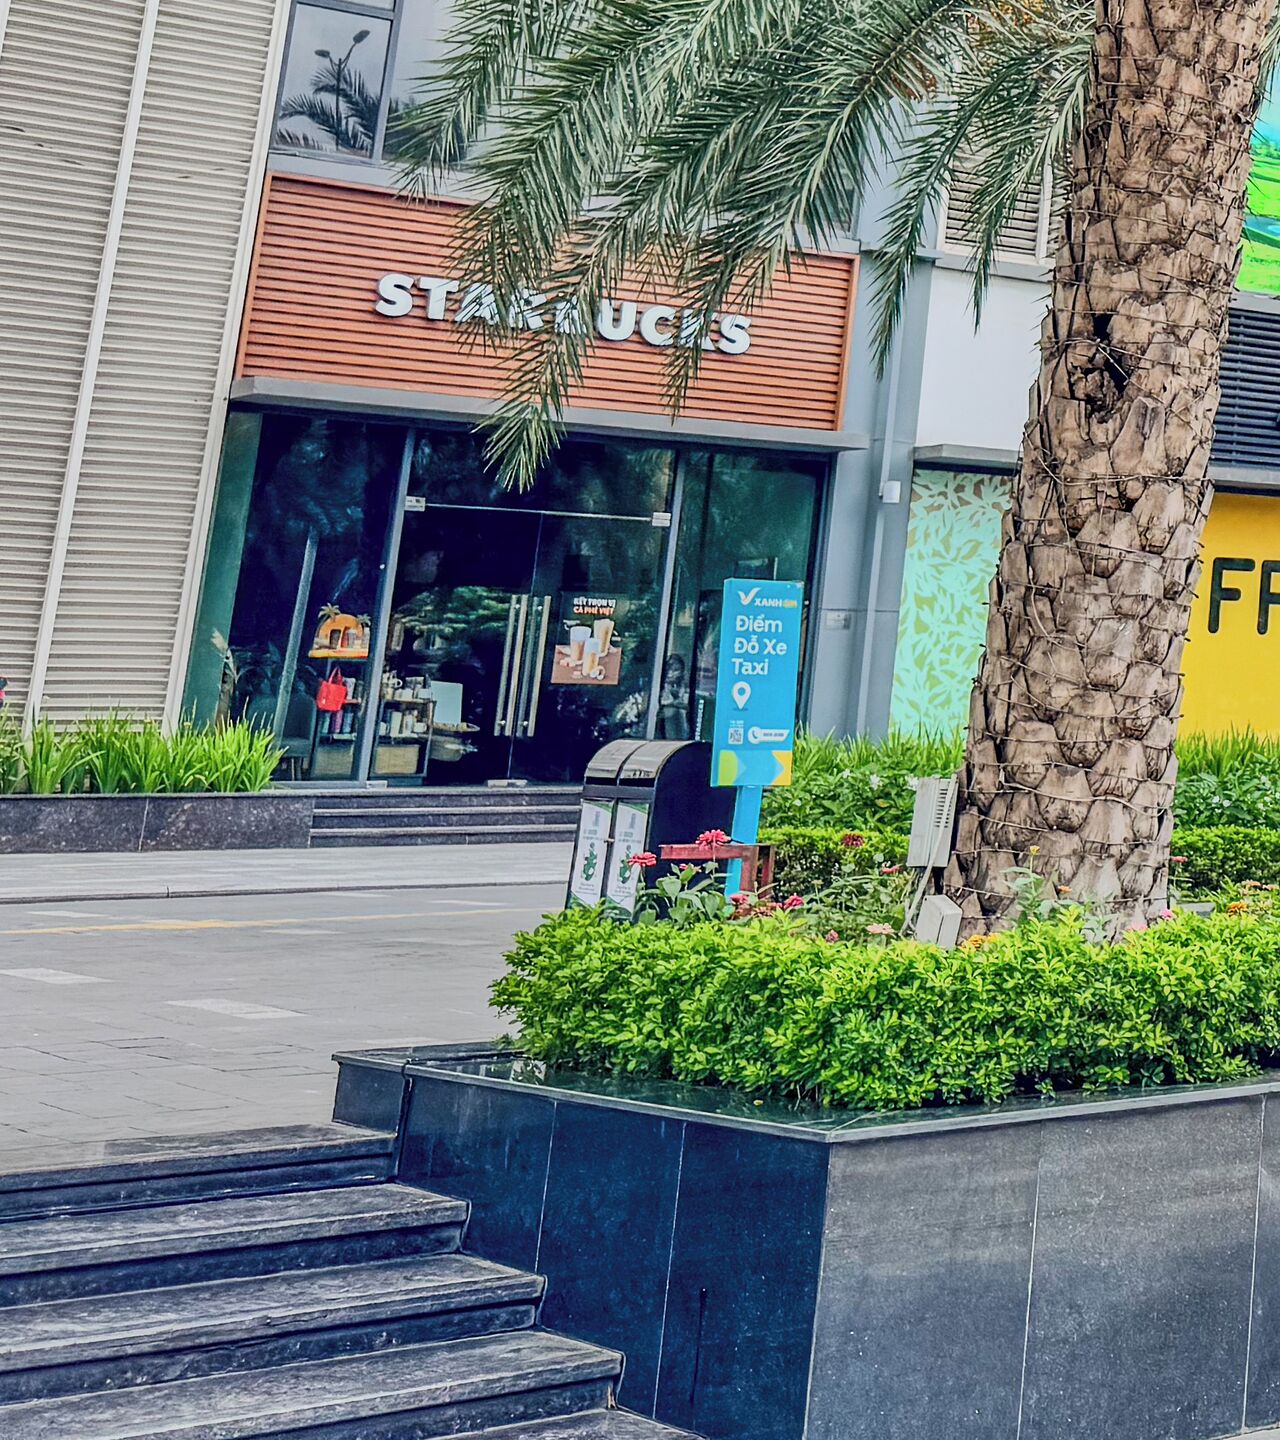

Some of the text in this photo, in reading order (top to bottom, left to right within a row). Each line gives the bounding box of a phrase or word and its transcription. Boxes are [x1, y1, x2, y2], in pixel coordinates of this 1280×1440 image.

[736, 614, 783, 633] Điểm
[734, 634, 787, 655] Đỗ Xe
[731, 657, 769, 675] Taxi
